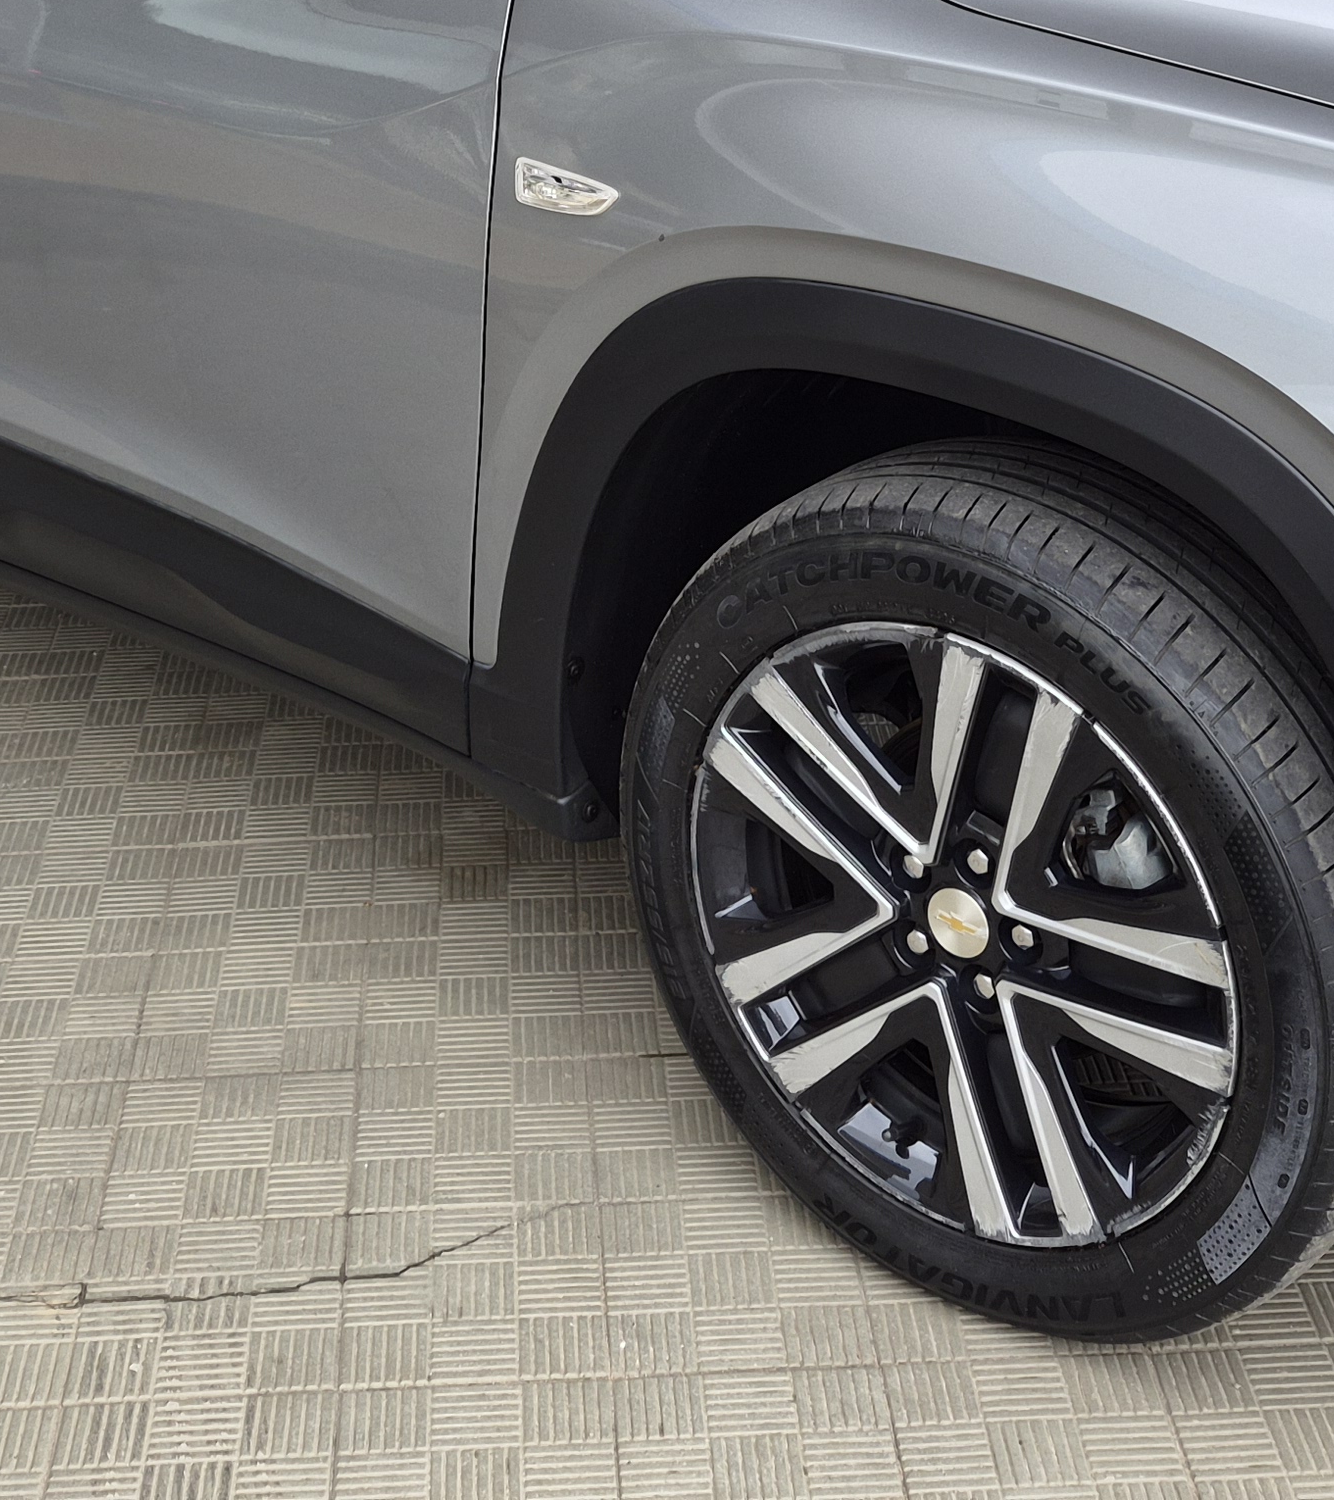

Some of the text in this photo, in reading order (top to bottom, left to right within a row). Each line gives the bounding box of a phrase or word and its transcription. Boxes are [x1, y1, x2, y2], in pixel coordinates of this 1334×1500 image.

[1053, 631, 1153, 716] PLUS
[1274, 1022, 1296, 1136] OUTSIDE
[823, 1192, 1127, 1322] LANVIGATOR
